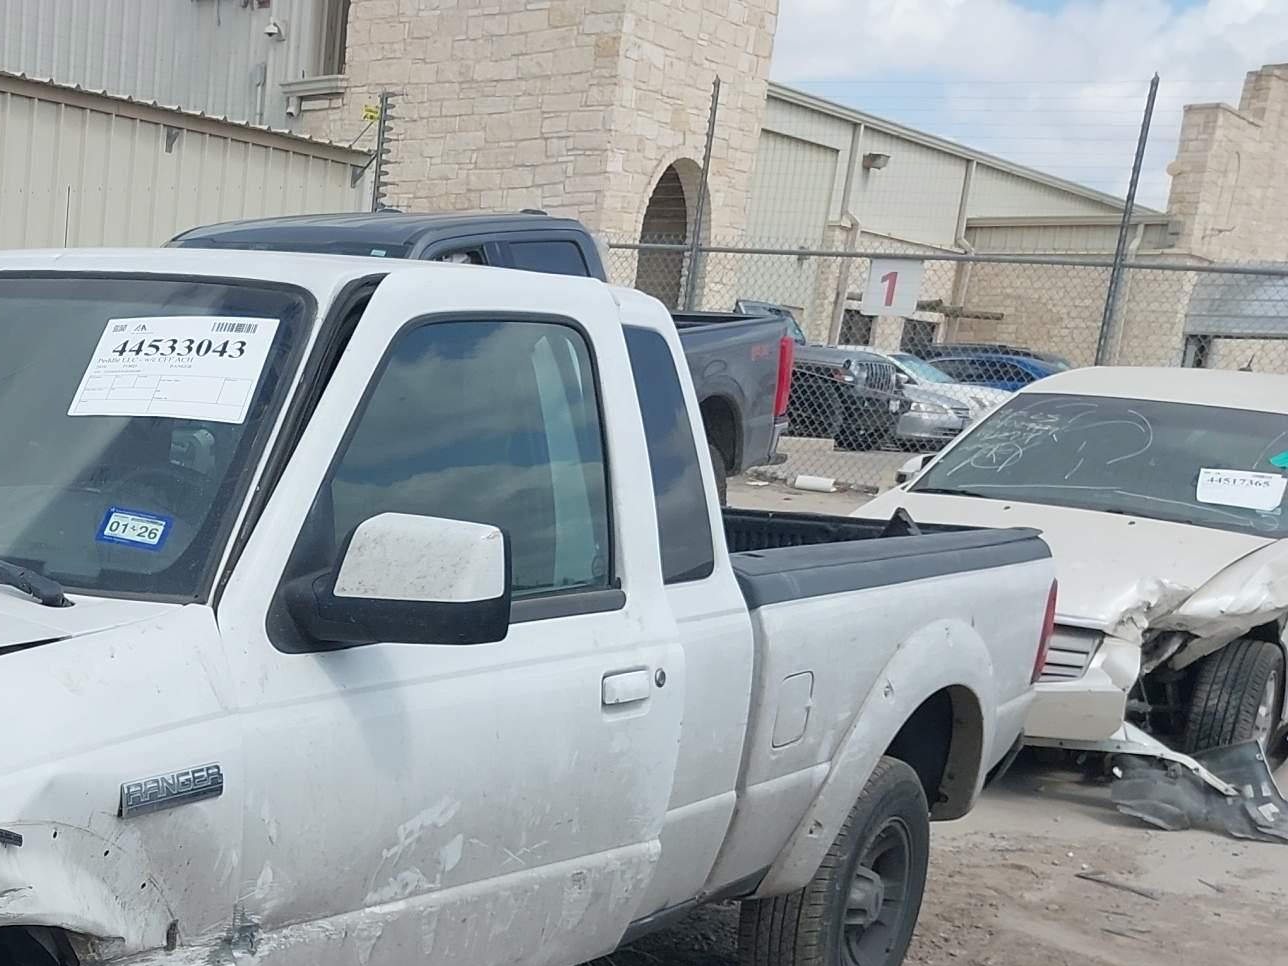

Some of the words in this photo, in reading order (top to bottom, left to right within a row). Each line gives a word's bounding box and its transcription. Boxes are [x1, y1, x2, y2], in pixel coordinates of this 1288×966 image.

[880, 271, 899, 307] 1
[112, 338, 247, 359] 44533043
[109, 521, 128, 533] 01
[136, 526, 159, 539] 26
[124, 763, 223, 806] RANGER
